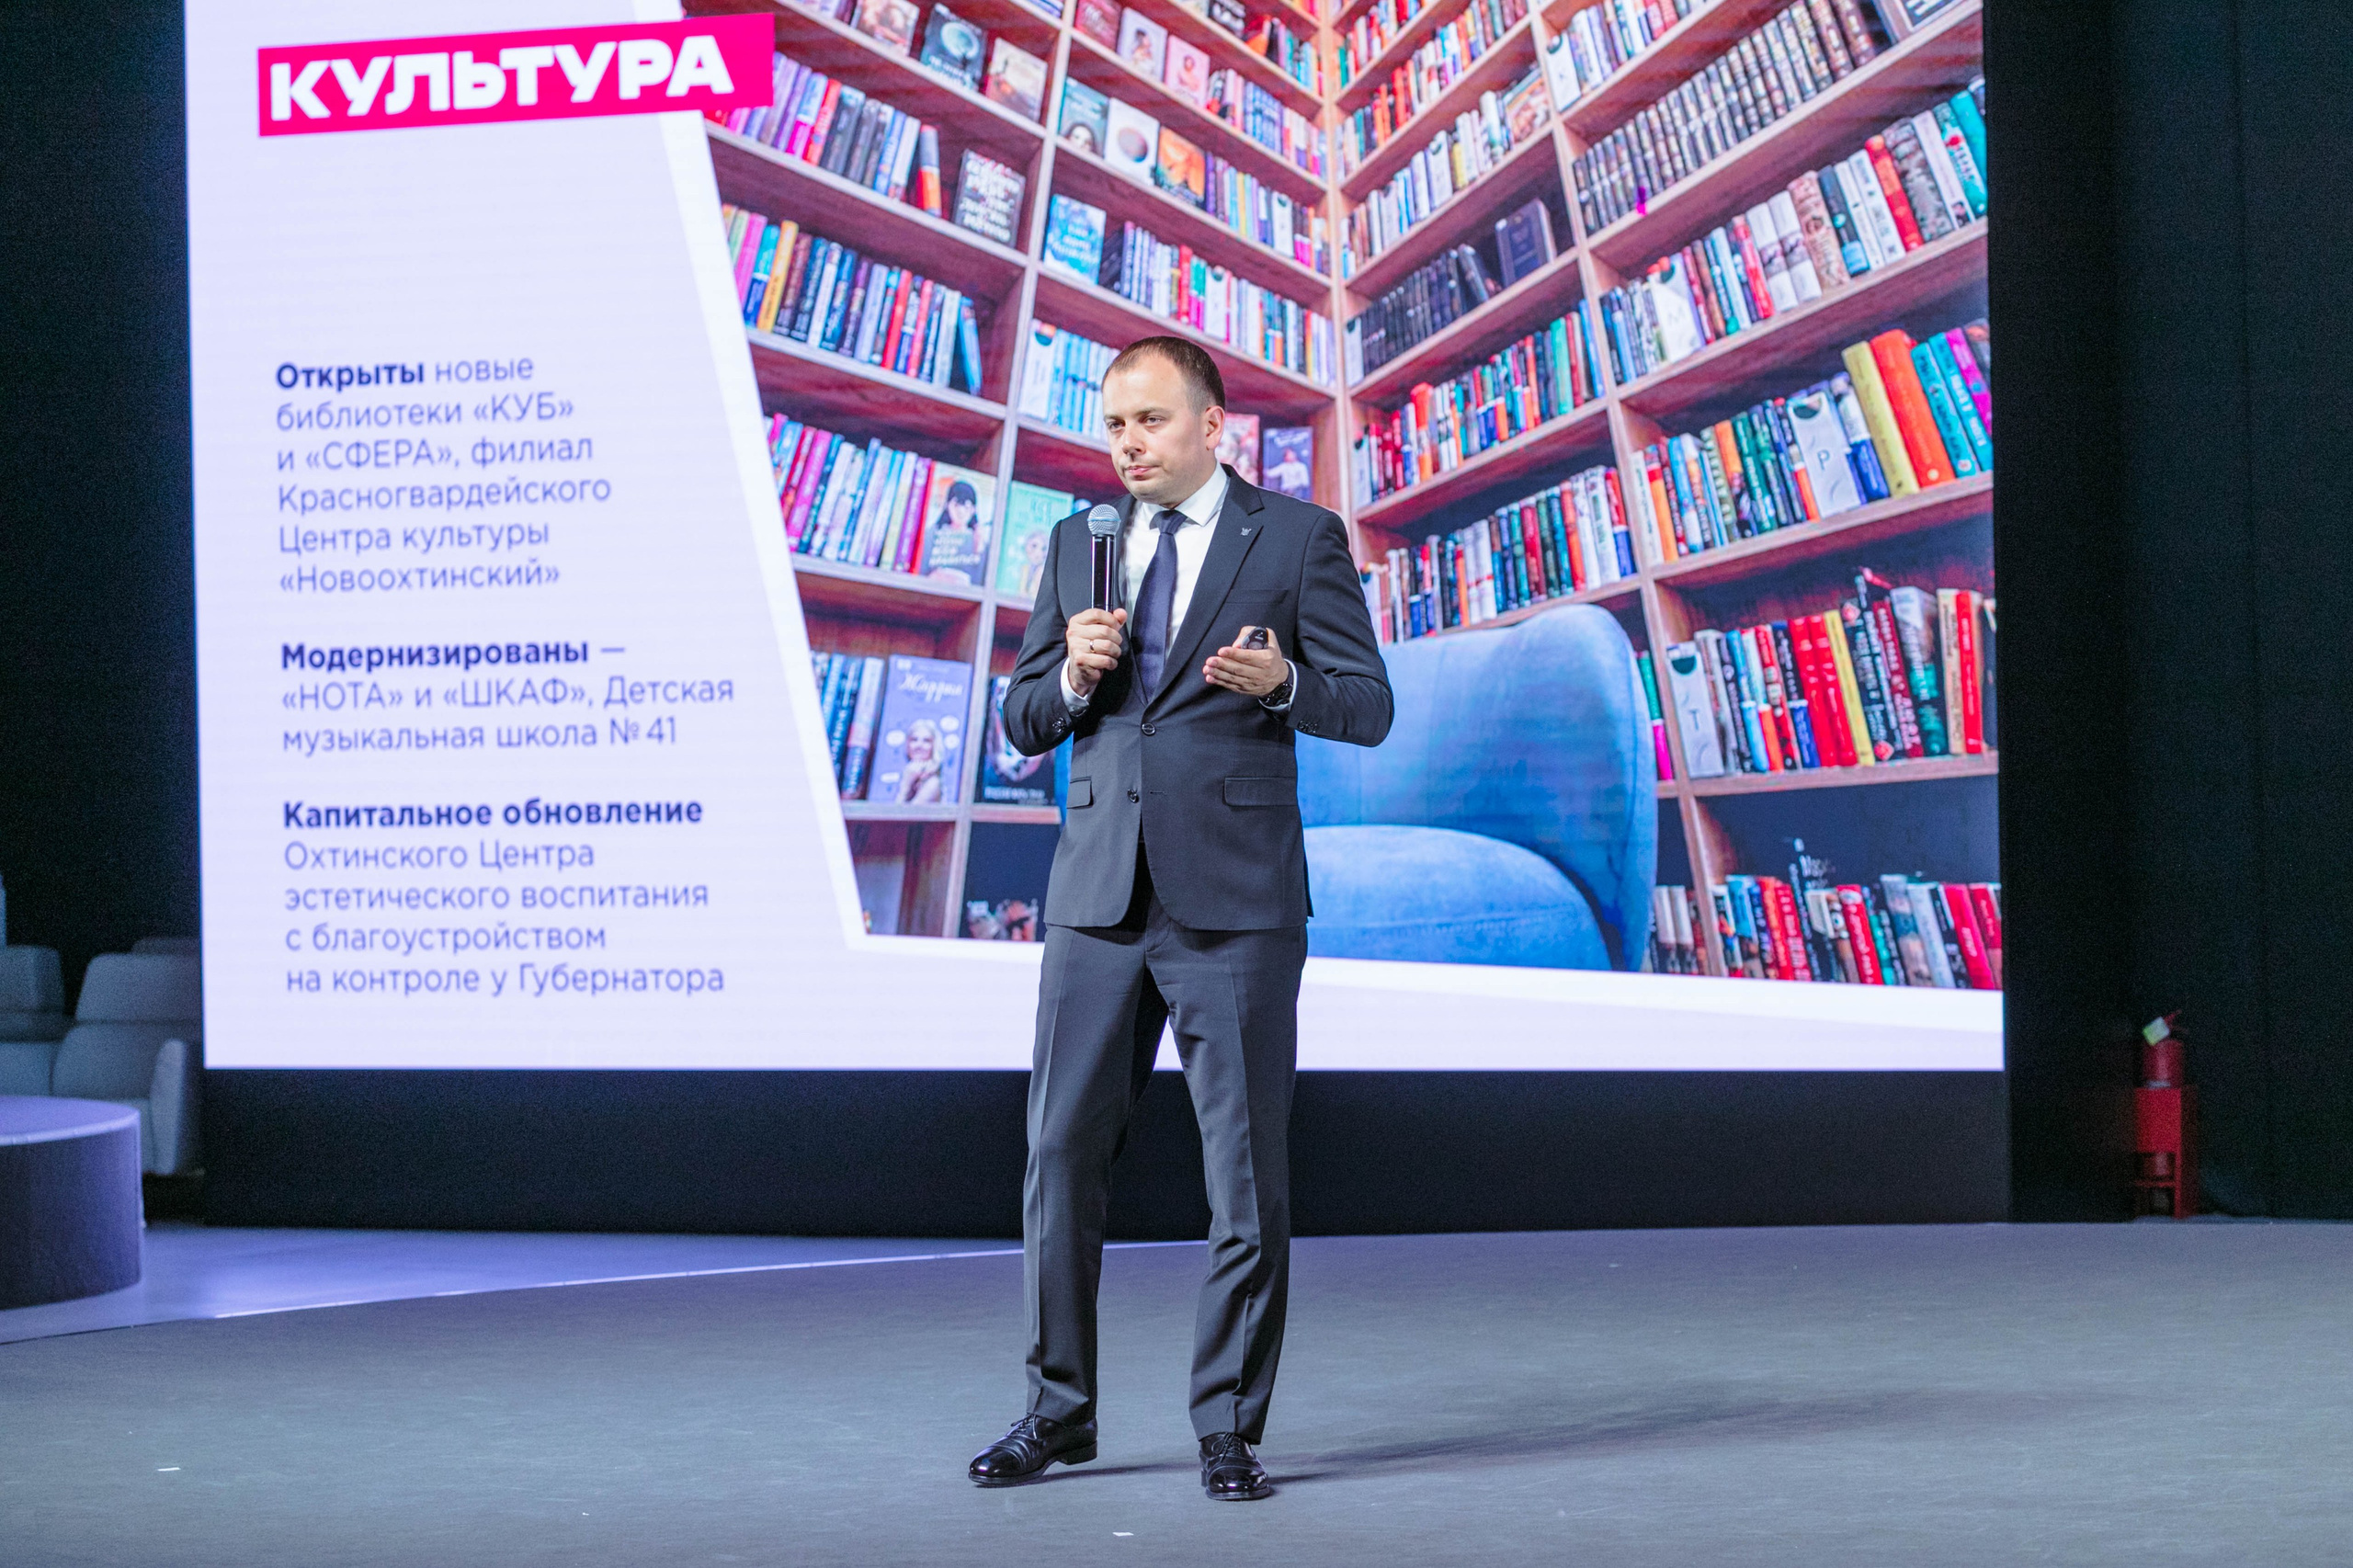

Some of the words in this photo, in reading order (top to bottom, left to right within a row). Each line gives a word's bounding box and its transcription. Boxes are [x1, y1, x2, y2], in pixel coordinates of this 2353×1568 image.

[270, 35, 734, 121] КУЛЬТУРА
[275, 361, 425, 394] Открыты
[436, 358, 534, 383] новые
[277, 401, 461, 431] библиотеки
[473, 392, 574, 422] «КУБ»
[278, 450, 294, 472] и
[306, 438, 460, 470] «СФЕРА»,
[472, 437, 592, 469] филиал
[278, 476, 611, 517] Красногвардейского
[279, 525, 391, 557] Центра
[404, 524, 549, 554] культуры
[280, 557, 560, 593] «Новоохтинский»
[281, 641, 589, 675] Модернизированы
[282, 681, 403, 710] «НОТА»
[415, 687, 431, 708] и
[444, 676, 593, 708] «ШКАФ»,
[603, 676, 733, 709] Детская
[283, 726, 484, 757] музыкальная
[497, 724, 597, 748] школа
[283, 801, 493, 830] Капитальное
[502, 796, 704, 826] обновление
[284, 841, 468, 870] Охтинского
[480, 840, 595, 872] Центра
[286, 886, 510, 911] эстетического
[521, 885, 708, 909] воспитания
[286, 928, 301, 951] с
[313, 922, 606, 956] благоустройством
[287, 970, 321, 993] на
[333, 970, 480, 997] контроле
[491, 971, 507, 997] у
[519, 962, 724, 997] Губернатора
